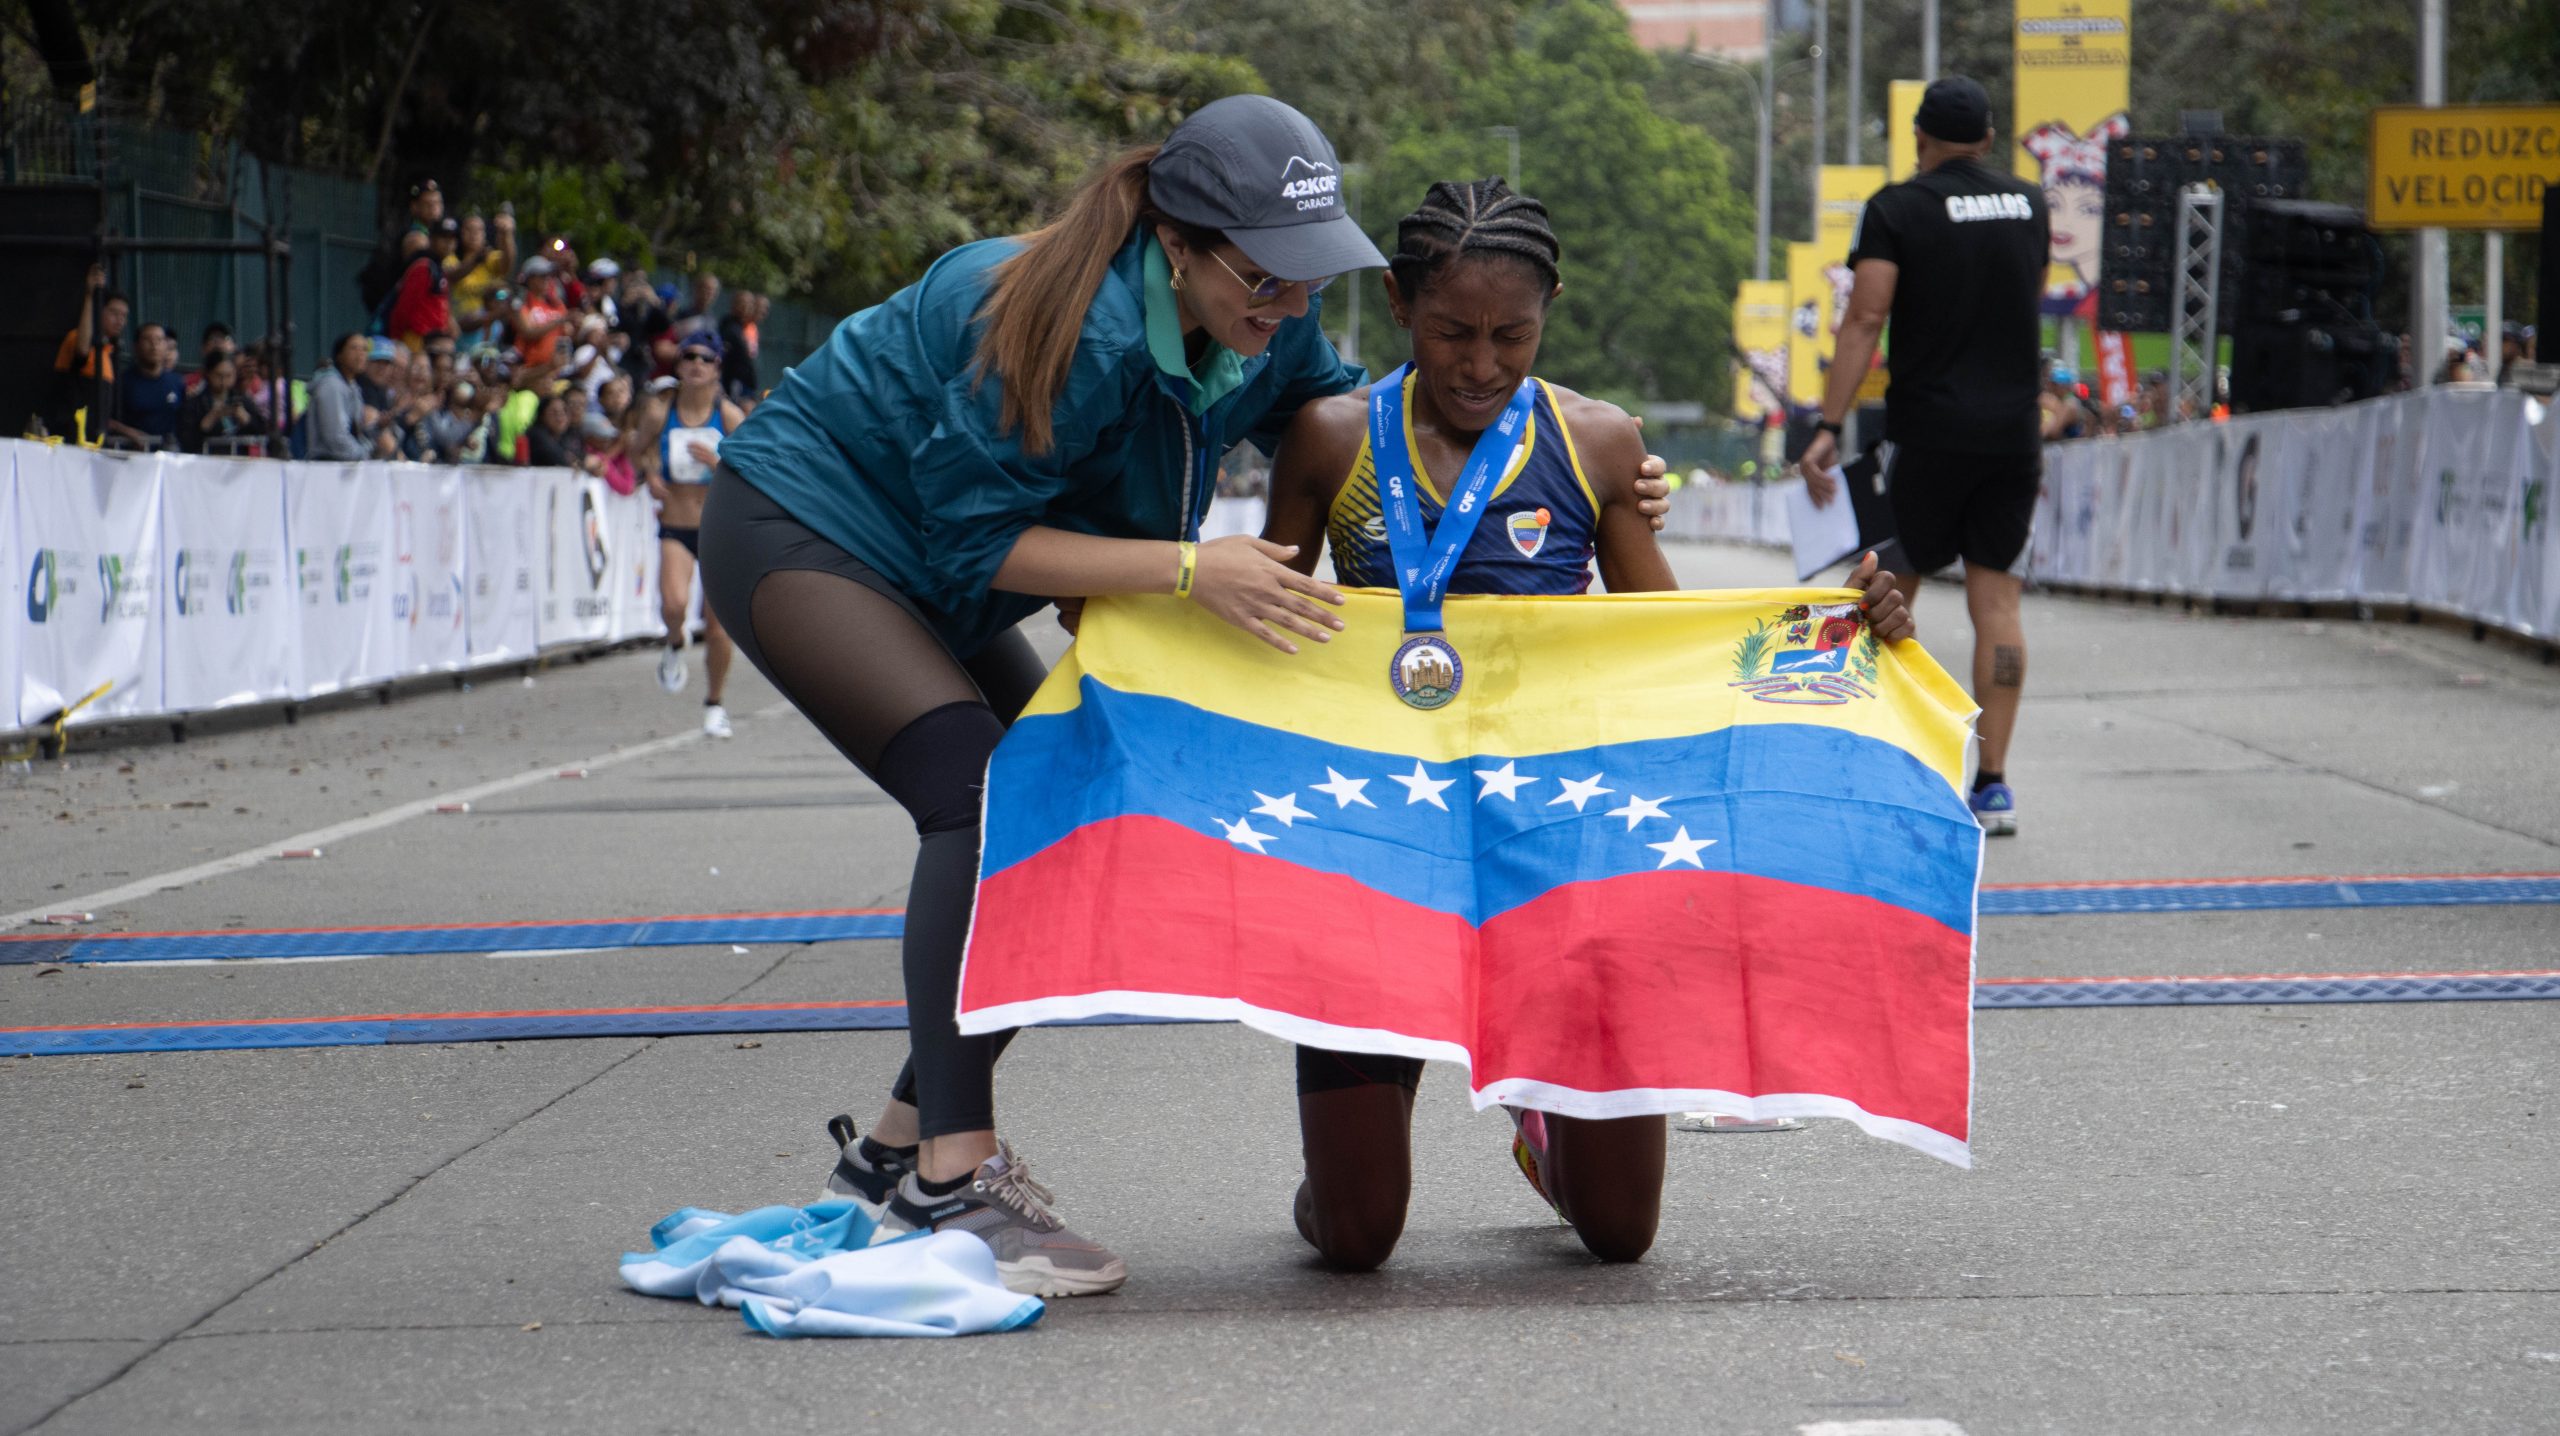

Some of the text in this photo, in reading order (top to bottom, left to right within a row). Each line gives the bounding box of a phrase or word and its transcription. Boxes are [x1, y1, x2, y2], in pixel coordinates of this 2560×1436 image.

[2411, 127, 2560, 160] REDUZC
[2386, 173, 2560, 208] VELOCID
[1944, 192, 2033, 223] CARLOS
